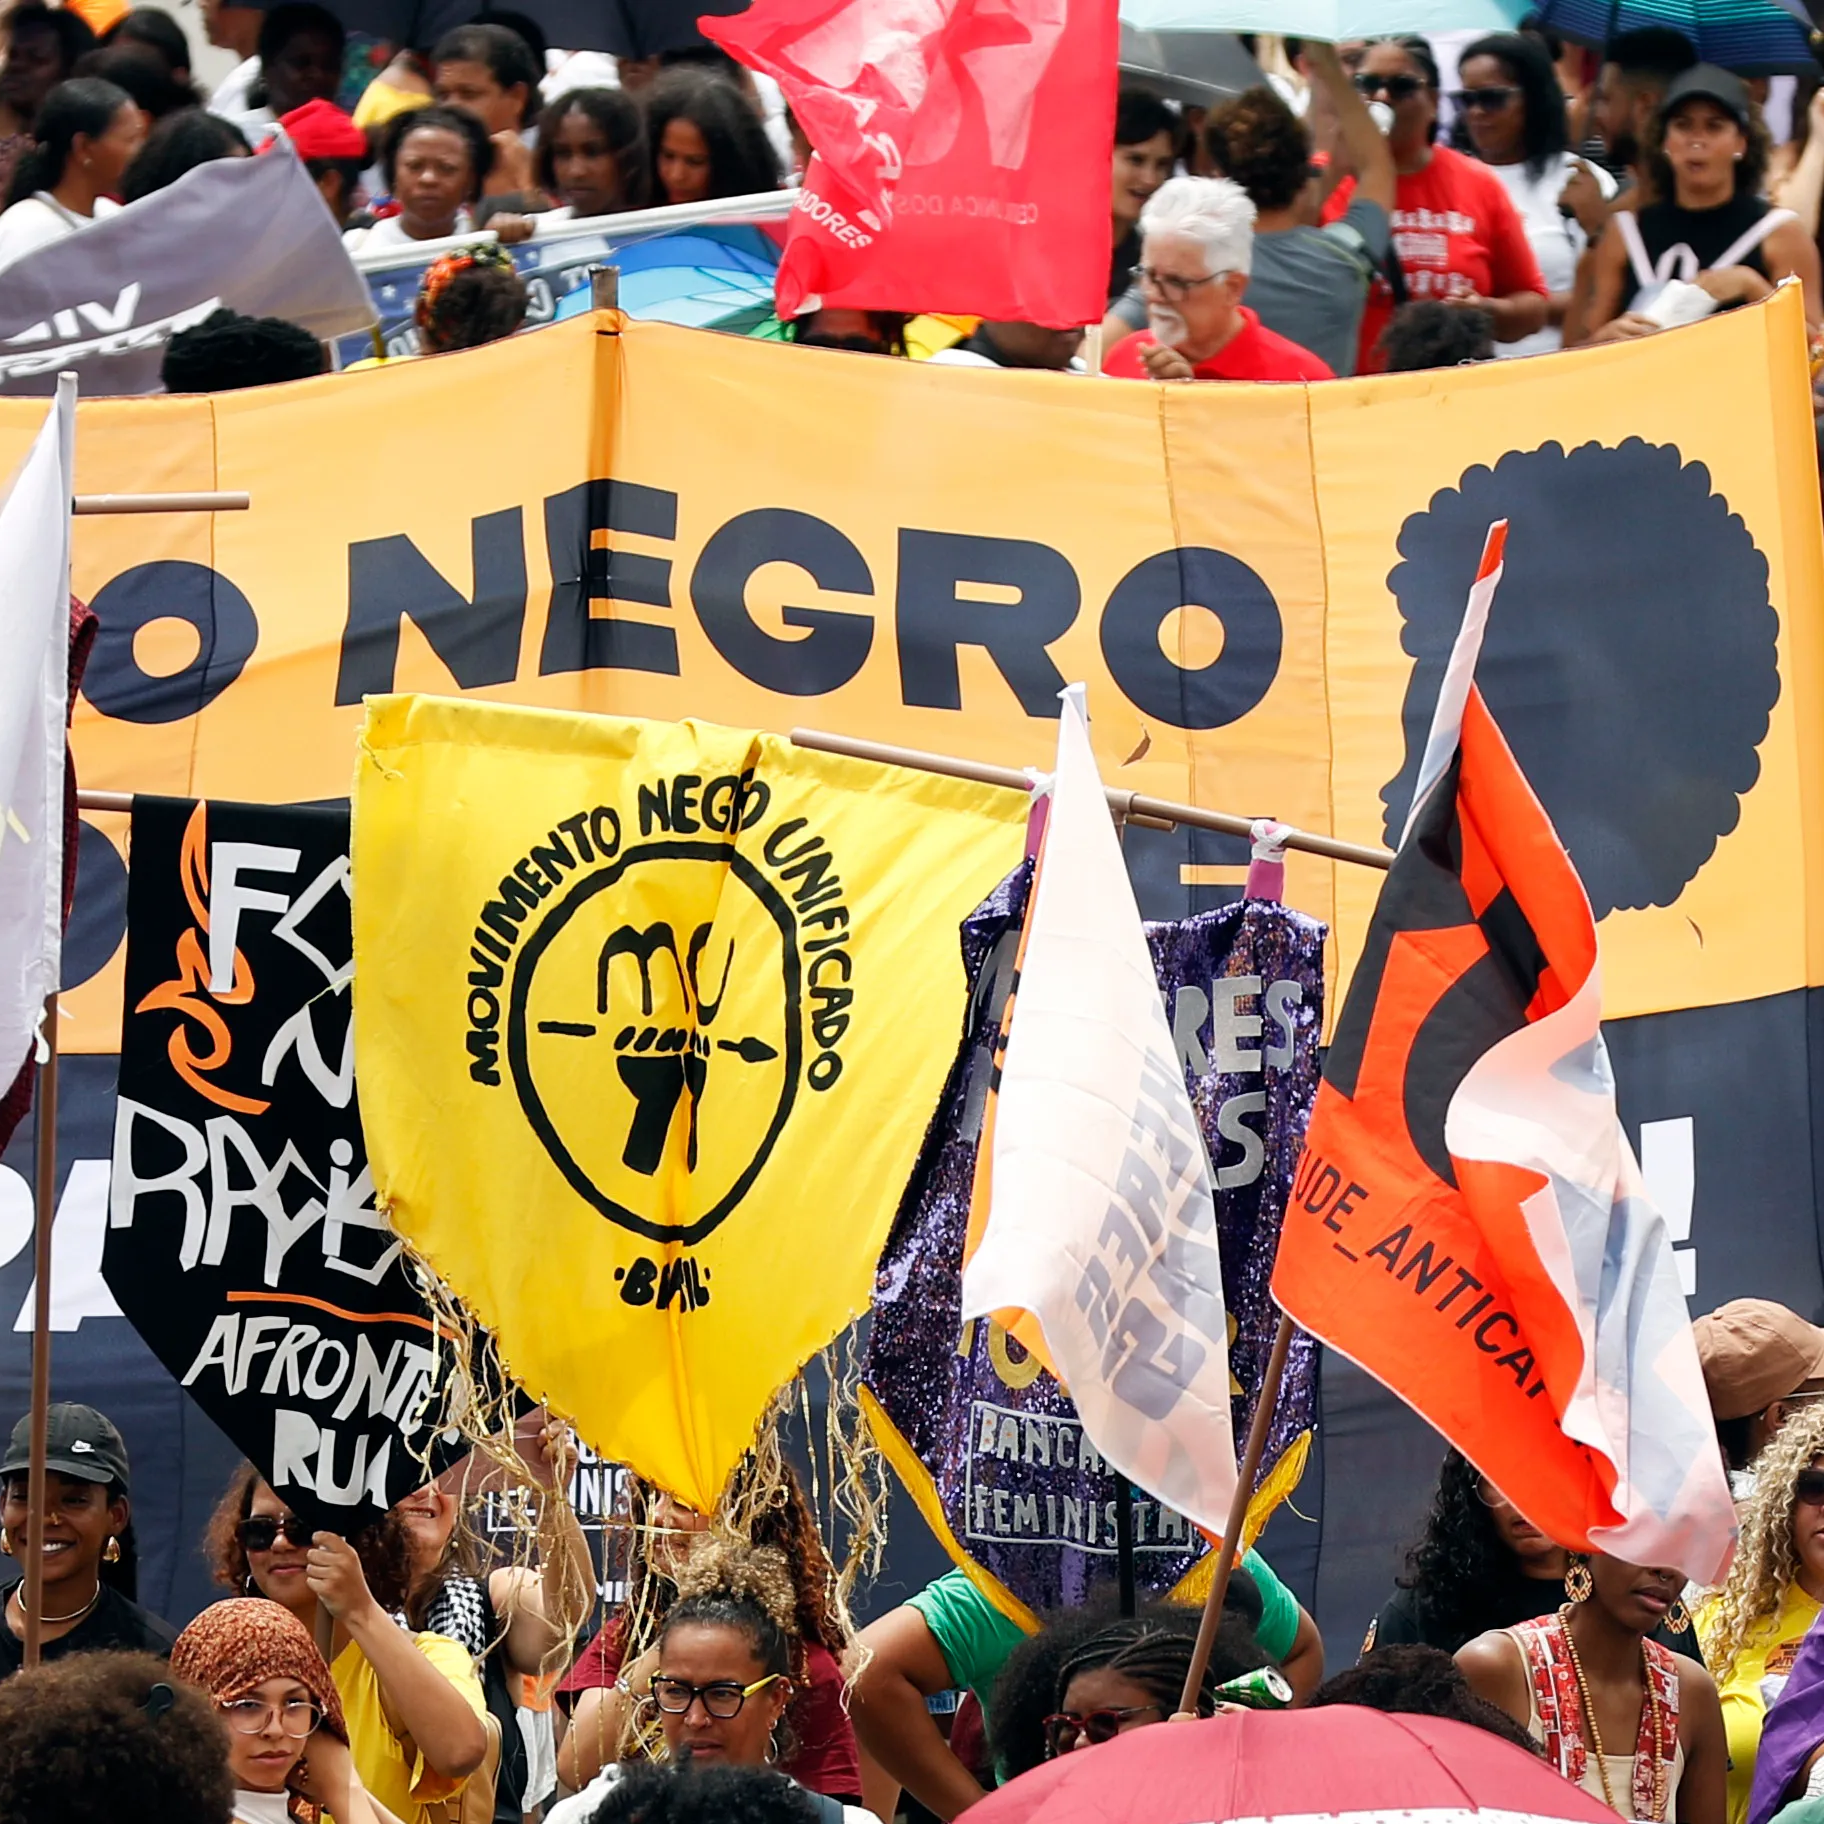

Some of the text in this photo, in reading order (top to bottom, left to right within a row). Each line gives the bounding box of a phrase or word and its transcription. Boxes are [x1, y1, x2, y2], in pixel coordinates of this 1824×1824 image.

[336, 478, 1283, 731] NEGRO
[466, 806, 622, 1088] MOVIMENTO
[763, 817, 856, 1093] UNIFICADO
[274, 1408, 395, 1512] RUA
